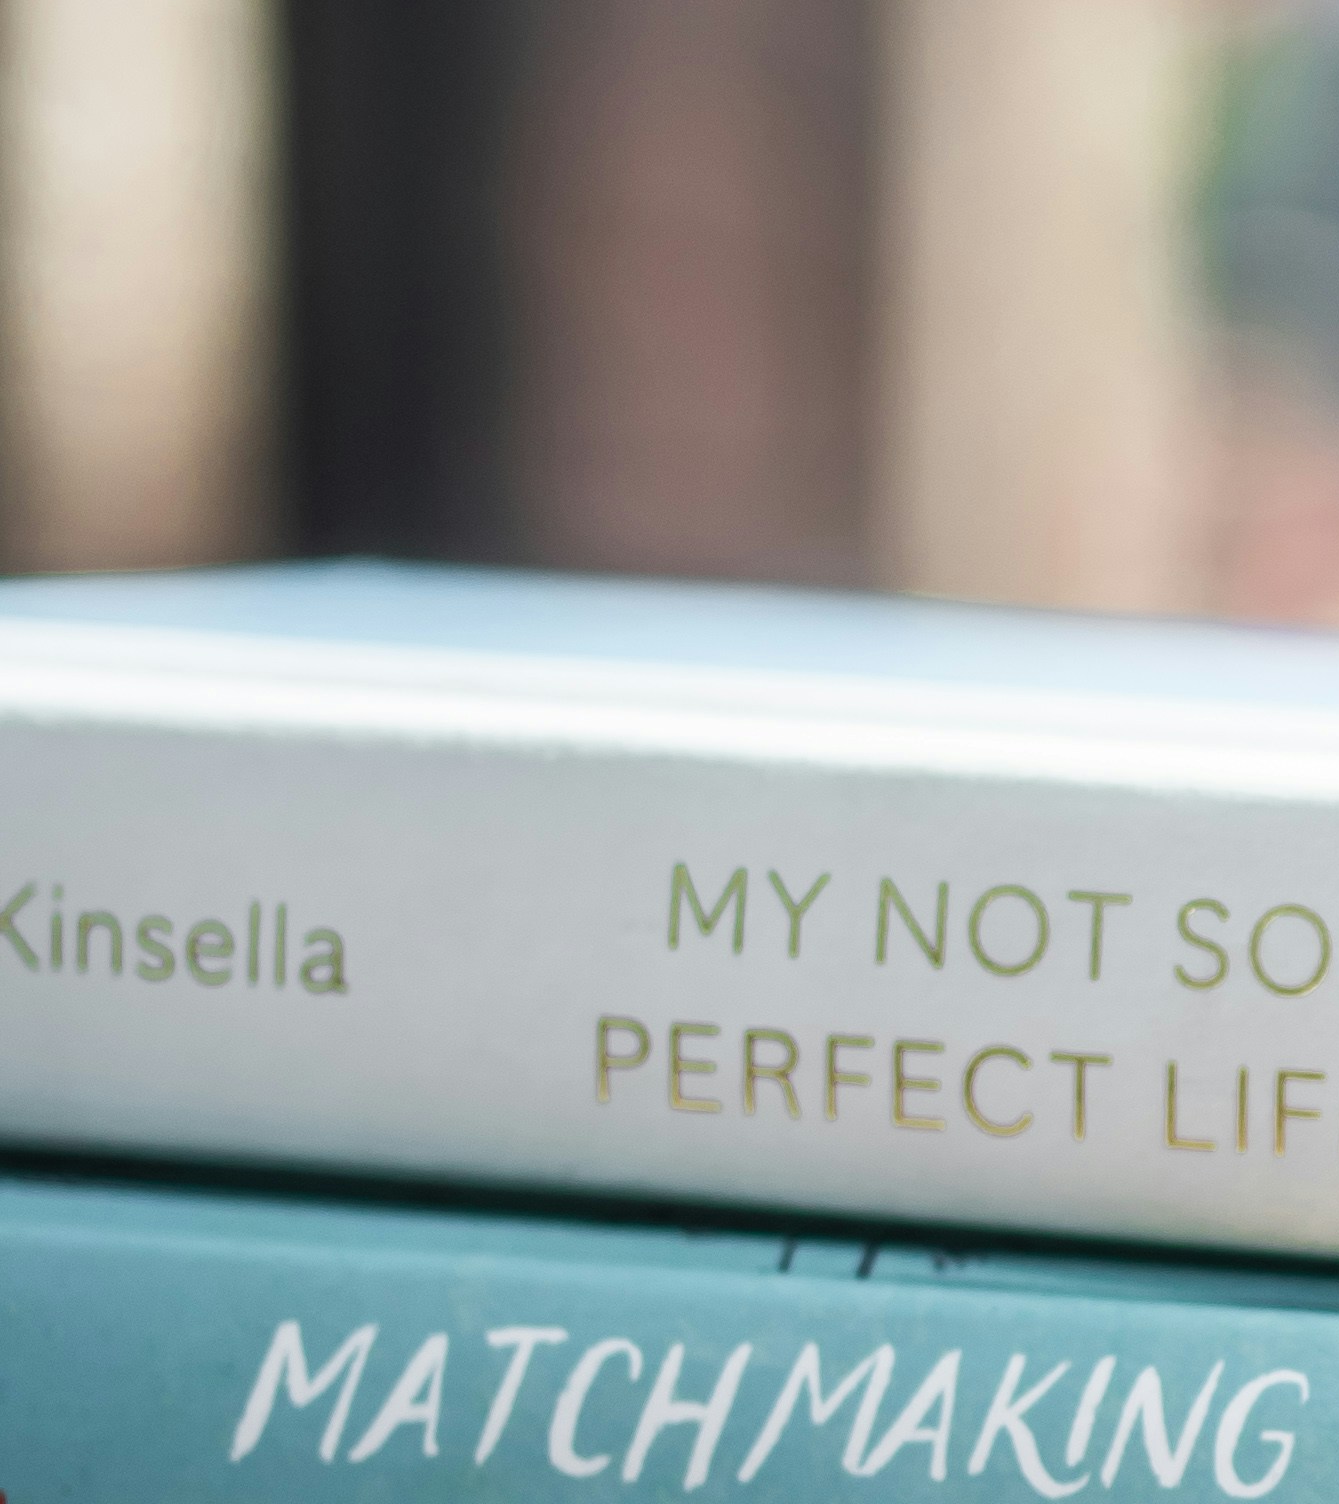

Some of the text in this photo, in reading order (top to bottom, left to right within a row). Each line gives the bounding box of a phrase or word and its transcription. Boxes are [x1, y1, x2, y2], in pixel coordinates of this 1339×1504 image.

[0, 880, 349, 994] Kinsella
[668, 862, 1334, 998] MY NOT SO
[594, 1014, 1112, 1141] PERFECT
[230, 1320, 1311, 1499] MATCHMAKING
